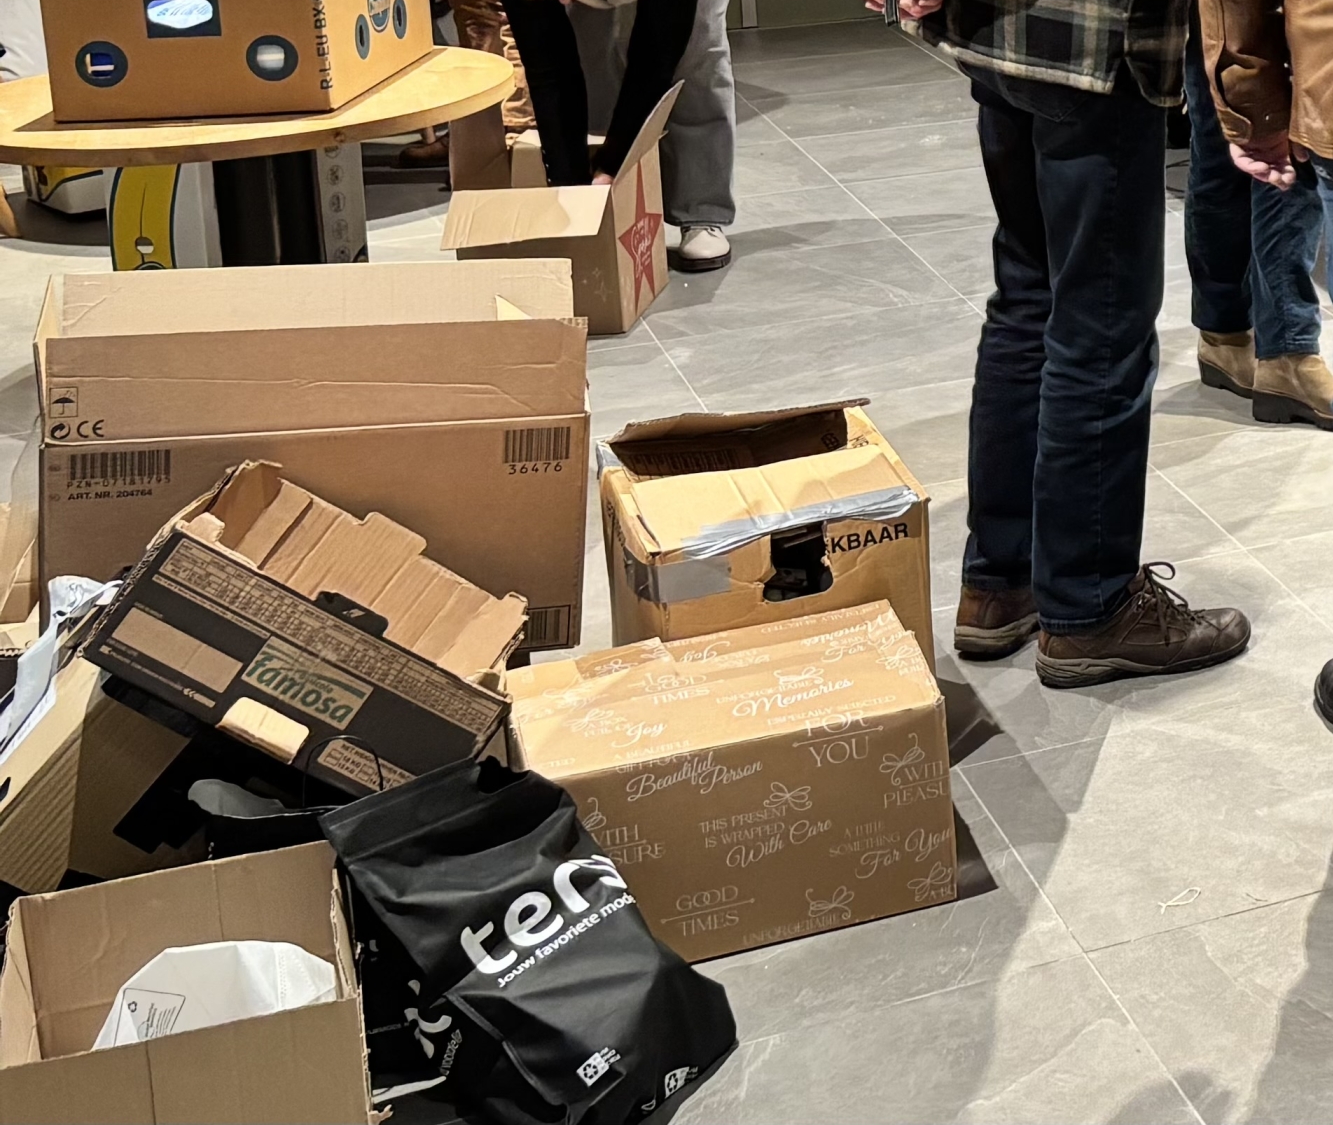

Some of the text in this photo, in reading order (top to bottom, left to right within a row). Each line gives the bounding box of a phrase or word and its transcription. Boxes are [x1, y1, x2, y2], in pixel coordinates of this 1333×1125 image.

[77, 419, 105, 439] CE
[507, 460, 564, 475] 36476
[68, 488, 153, 502] ART. NR. 204764
[824, 522, 909, 556] KBAAR
[732, 678, 855, 717] Memories
[805, 709, 869, 737] FOR
[809, 735, 869, 768] YOU
[626, 751, 763, 802] Beautiful Person
[700, 805, 789, 834] THIS PRESENT
[705, 821, 785, 849] IS WRAPPED
[726, 819, 833, 868] With Care
[829, 832, 900, 857] SOMETHING
[854, 828, 951, 879] For You
[676, 885, 738, 912] GOOD
[460, 855, 628, 974] ter
[681, 910, 740, 936] TIMES
[497, 955, 536, 988] Jouw
[535, 911, 601, 959] favoriete
